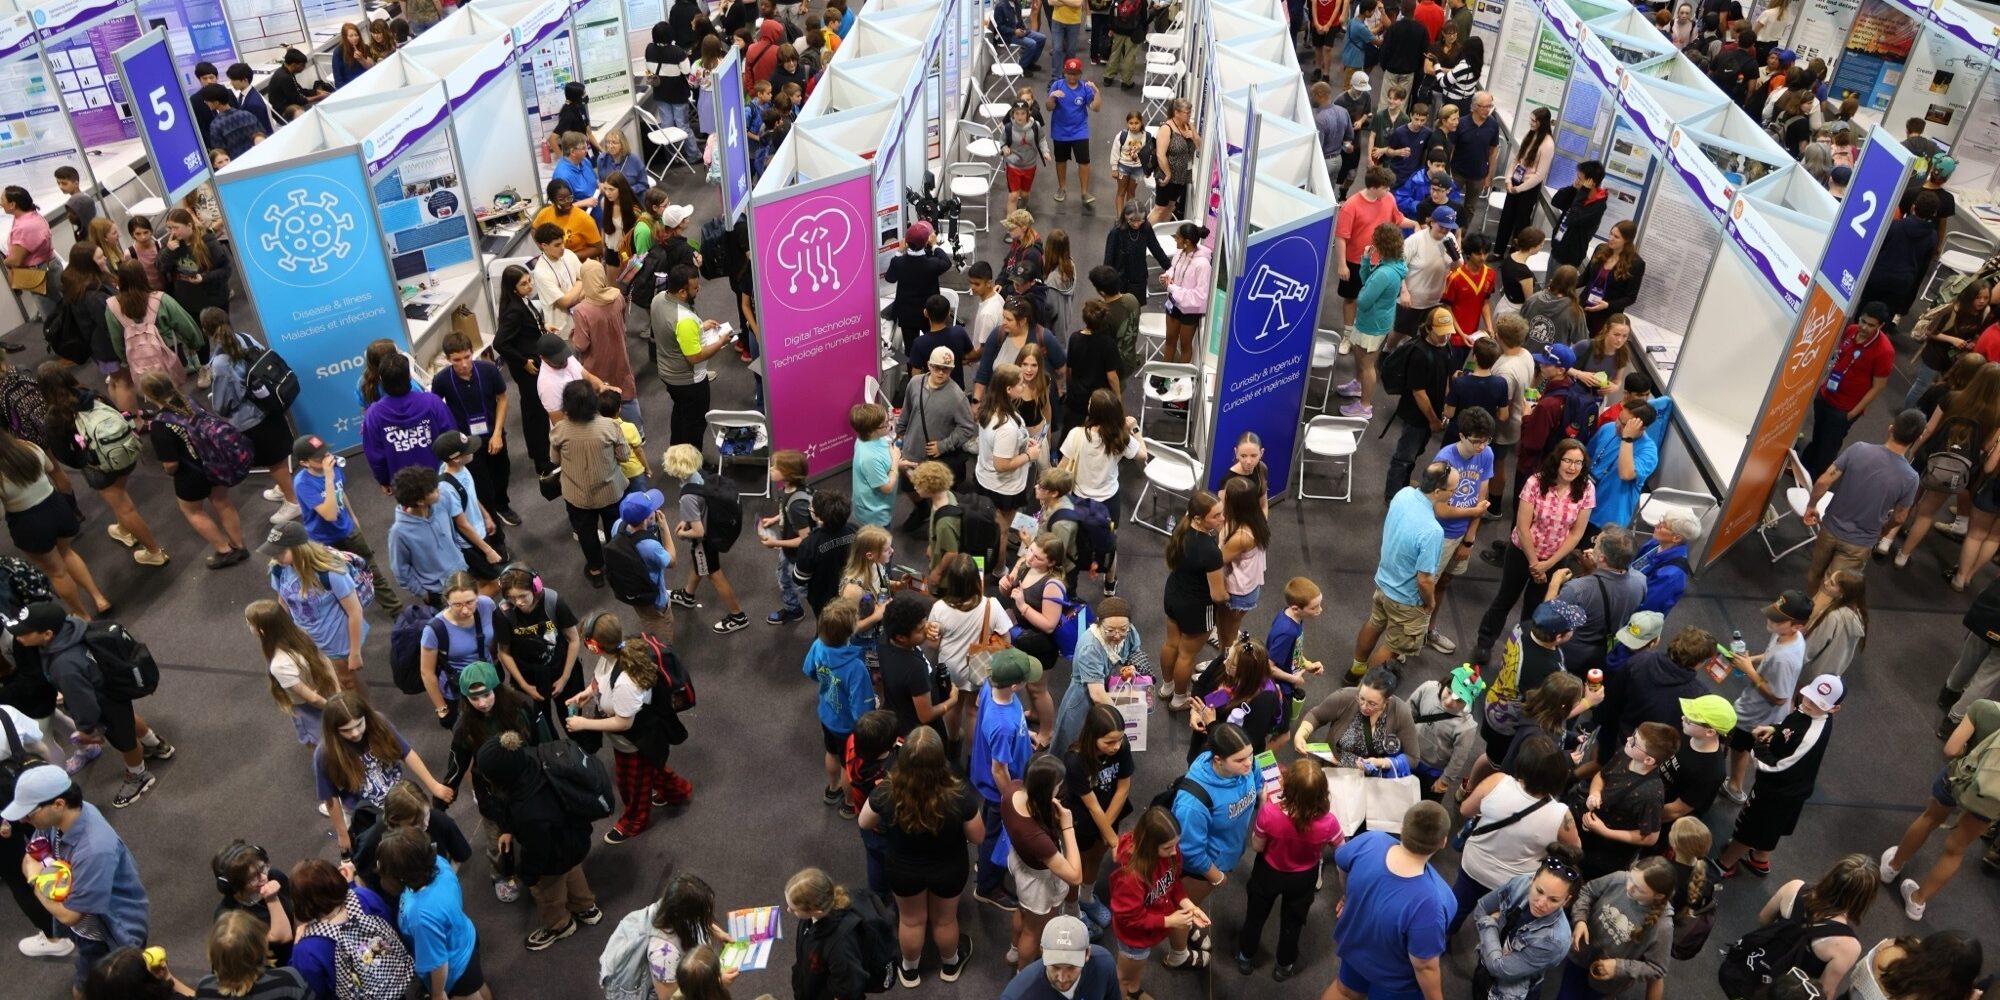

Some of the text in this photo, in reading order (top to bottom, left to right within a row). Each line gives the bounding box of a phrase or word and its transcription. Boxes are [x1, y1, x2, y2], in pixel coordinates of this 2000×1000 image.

[1916, 67, 1933, 75] Create
[149, 85, 175, 131] 5
[728, 107, 738, 148] 4
[1850, 190, 1877, 239] 2
[292, 292, 373, 321] Disease & Illness
[1784, 292, 1796, 307] 2302
[281, 305, 386, 343] Maladies et infections
[784, 313, 862, 347] Digital Technology
[771, 328, 870, 369] Technologie numérique
[1222, 370, 1300, 413] Curiosité et ingéniosité
[1230, 354, 1302, 392] Curiosity & ingenuity
[386, 426, 425, 443] CWSF
[394, 437, 428, 452] ESPC
